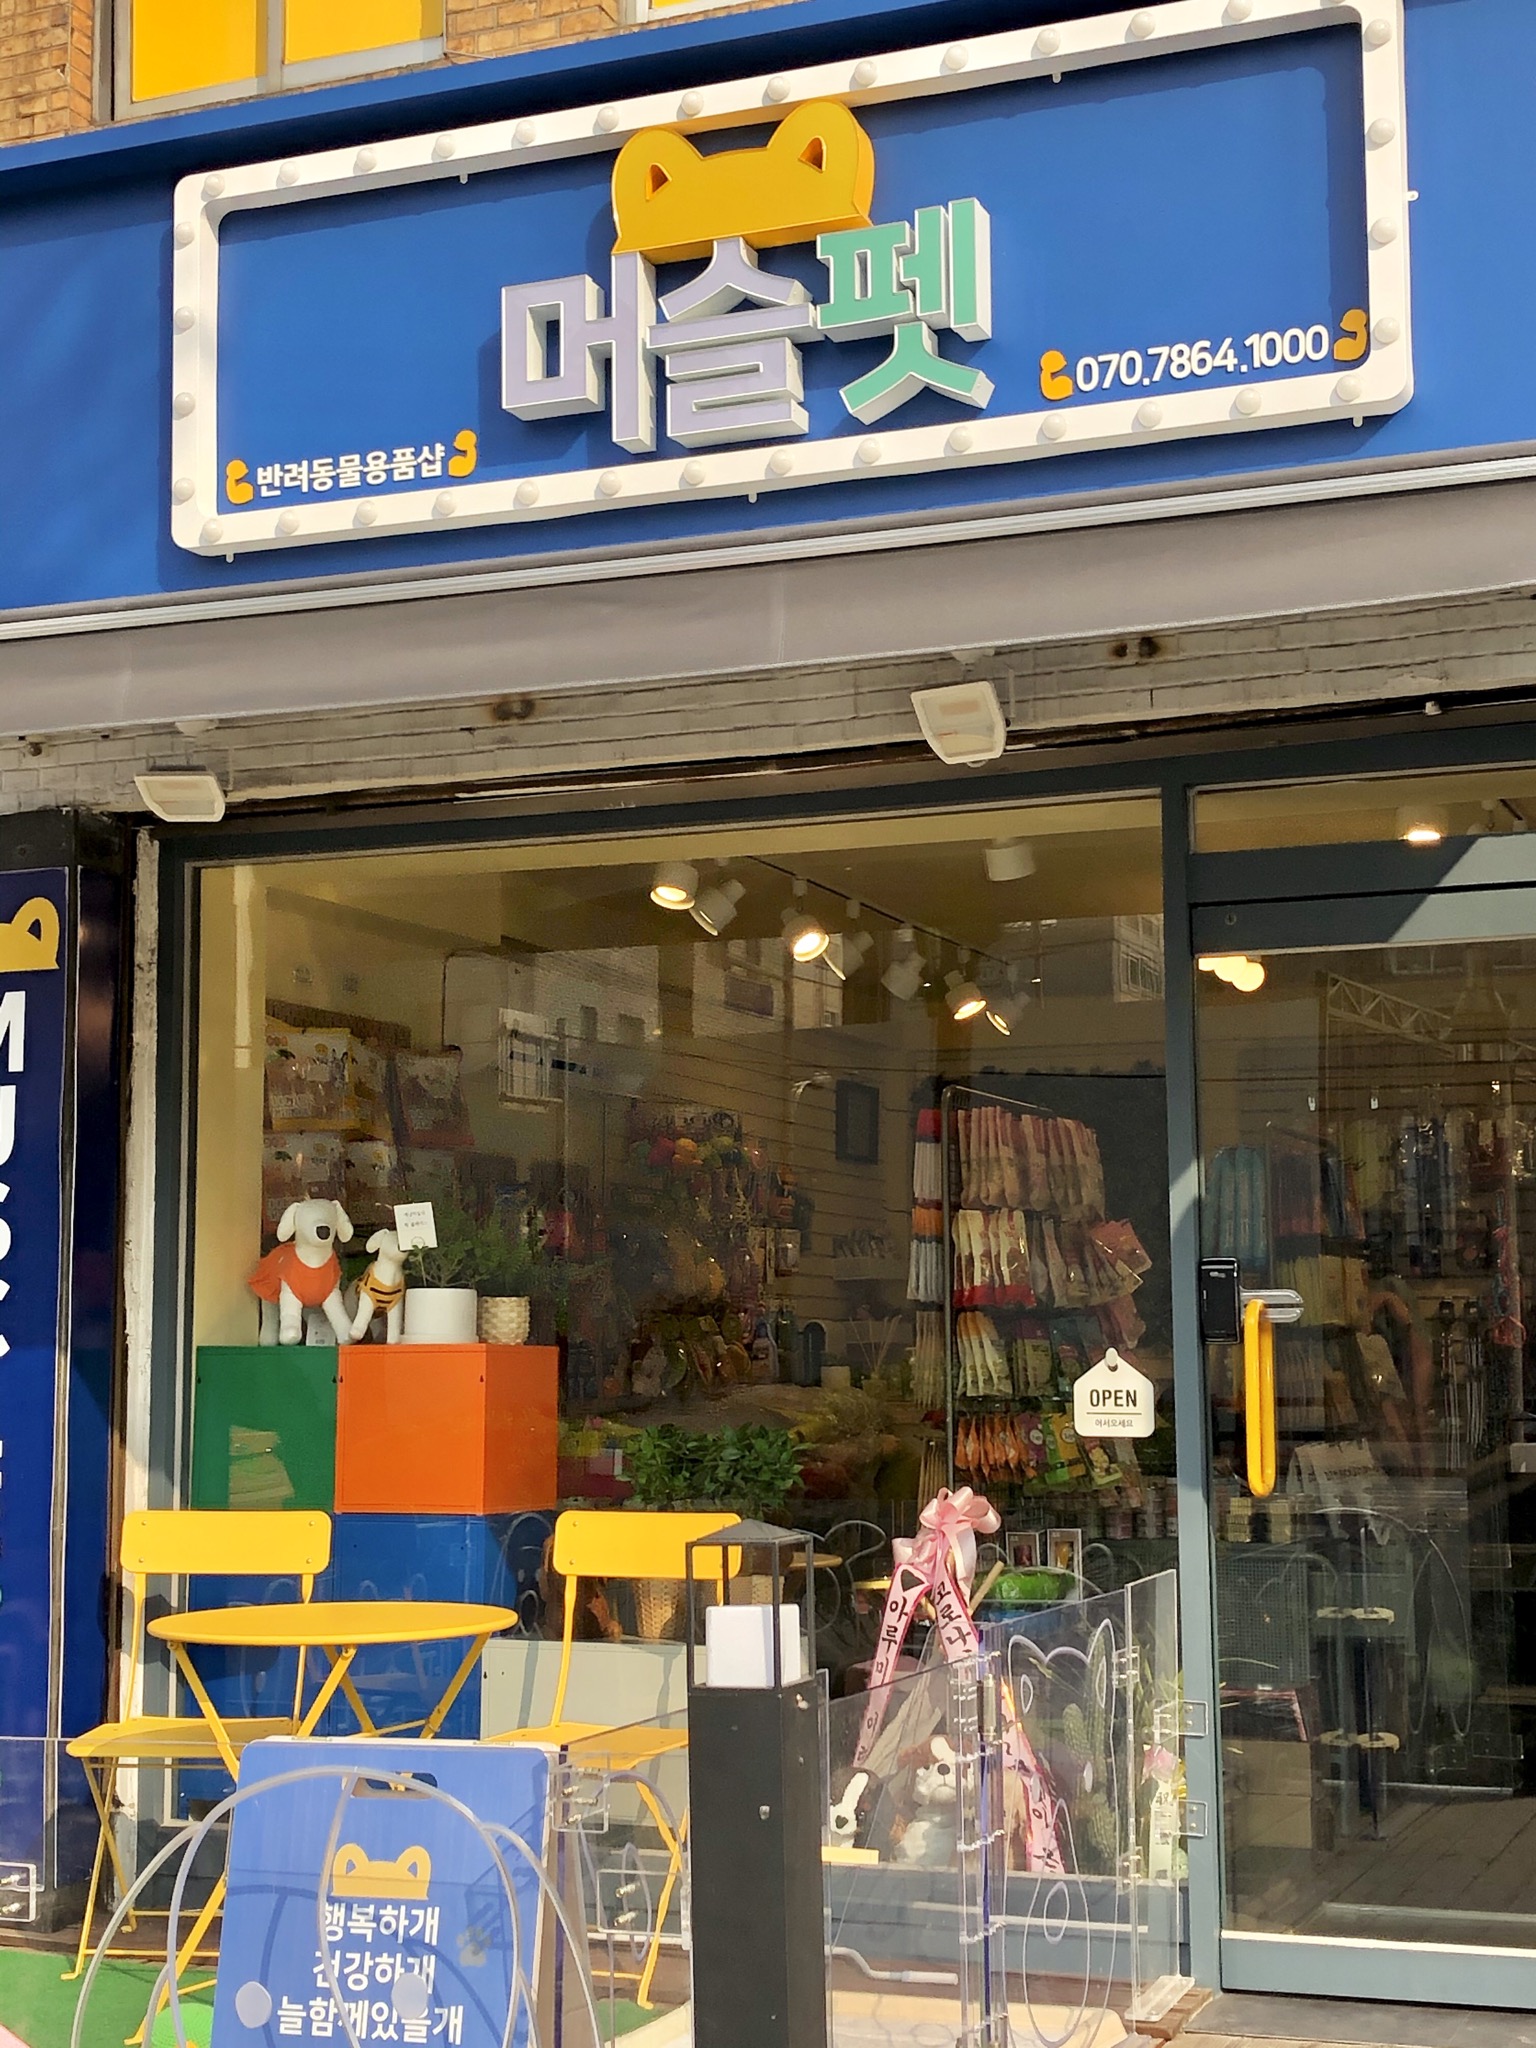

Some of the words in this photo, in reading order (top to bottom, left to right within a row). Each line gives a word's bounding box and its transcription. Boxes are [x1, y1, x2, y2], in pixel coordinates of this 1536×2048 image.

[501, 196, 995, 454] 머슬펫
[1075, 323, 1330, 394] 070.7864.1000
[256, 443, 446, 499] 반려동물용품샵
[1089, 1388, 1138, 1408] OPEN
[1095, 1418, 1134, 1429] 어서오세요
[324, 1902, 440, 1946] 행복하개
